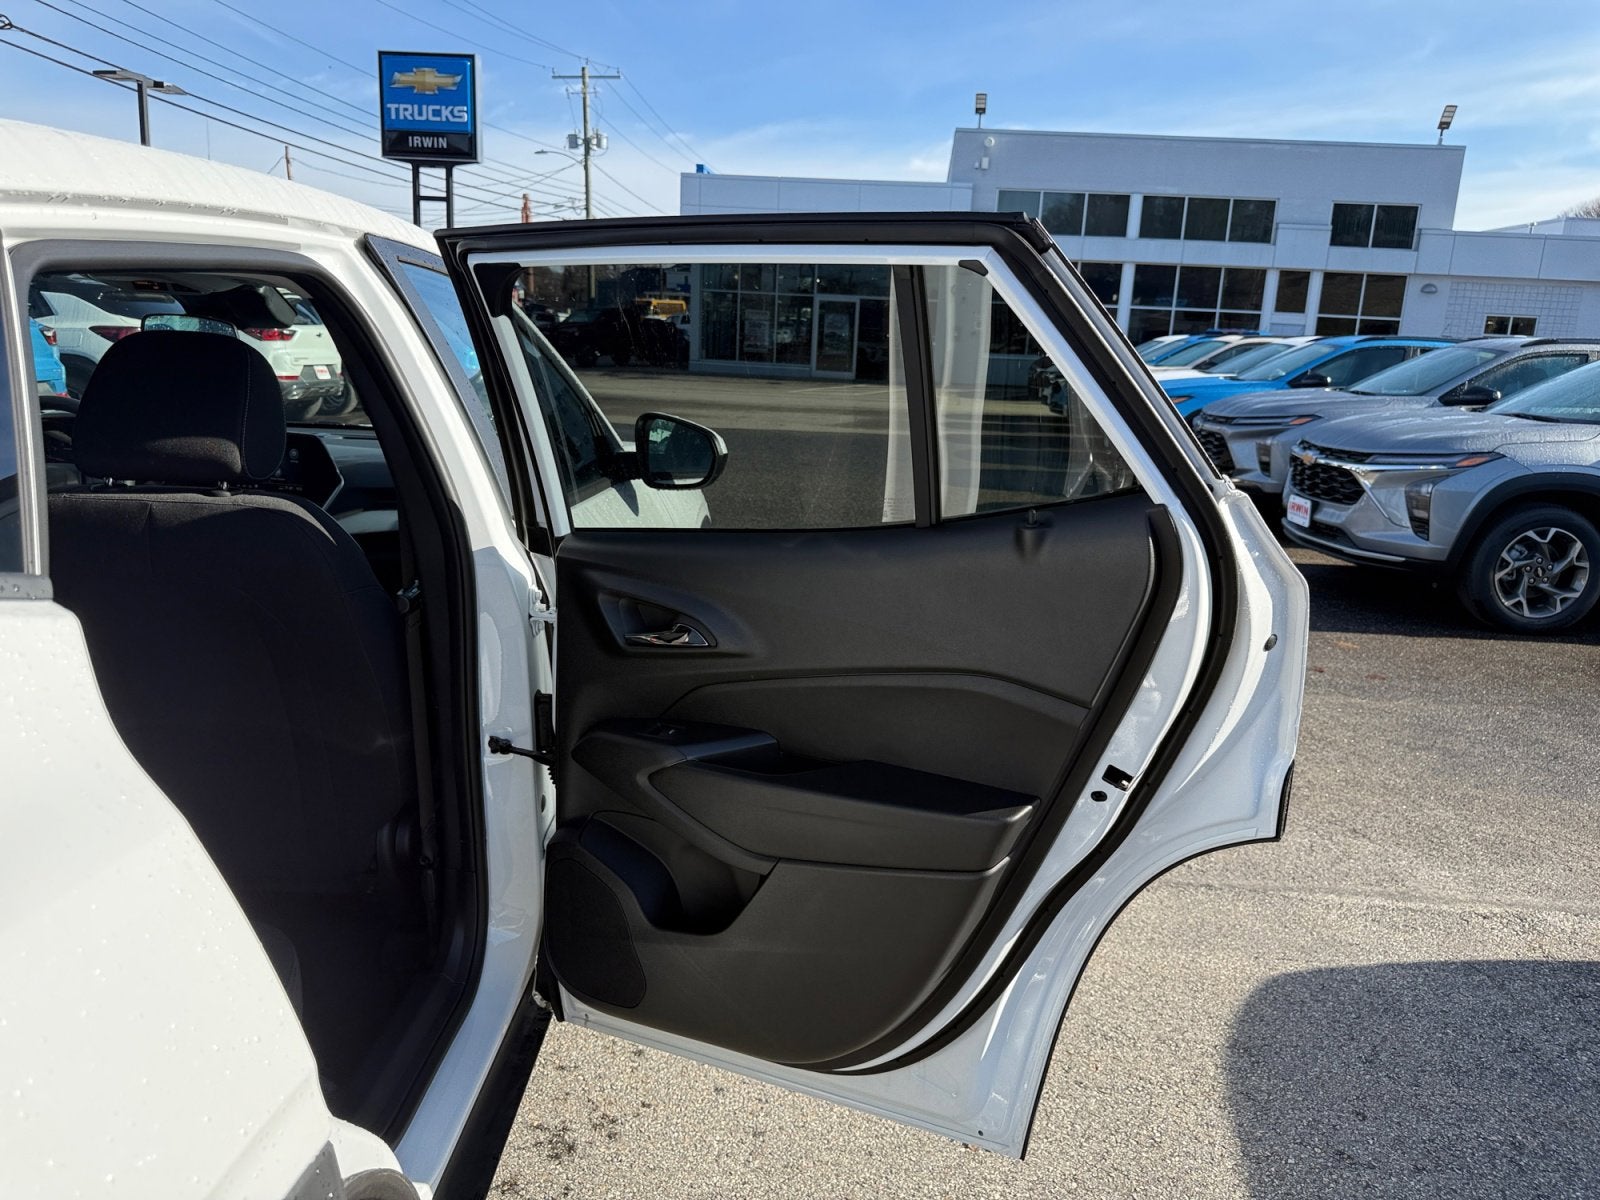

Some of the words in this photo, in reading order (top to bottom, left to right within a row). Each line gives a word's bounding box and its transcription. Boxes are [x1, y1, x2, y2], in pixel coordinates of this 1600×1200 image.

[387, 103, 468, 123] TRUCKS
[408, 136, 448, 149] IRWIN
[1289, 501, 1309, 516] IRWIN
